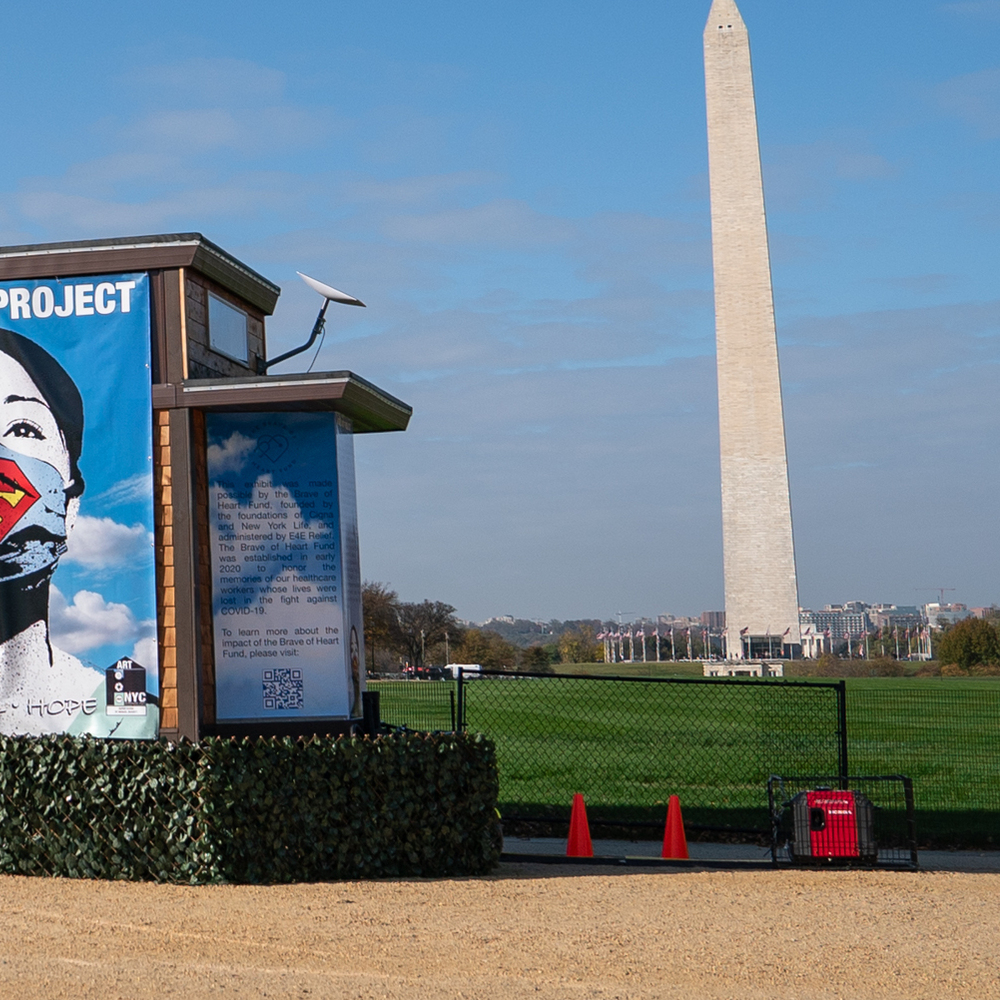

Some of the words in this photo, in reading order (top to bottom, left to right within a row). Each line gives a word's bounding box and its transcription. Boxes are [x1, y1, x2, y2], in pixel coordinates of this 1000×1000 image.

[218, 480, 235, 488] This
[244, 480, 273, 488] exhibit
[309, 479, 333, 487] made
[217, 490, 253, 500] possible
[258, 490, 269, 500] by
[275, 490, 289, 498] the
[294, 490, 318, 498] Brave
[217, 502, 241, 510] Heart
[248, 501, 273, 510] Fund,
[280, 501, 315, 509] founded
[323, 501, 333, 510] by
[218, 512, 231, 520] the
[238, 512, 288, 520] foundations
[294, 511, 303, 519] of
[309, 511, 334, 520] Cigna
[241, 522, 261, 530] New
[293, 521, 311, 530] Life,
[318, 521, 334, 529] and
[218, 533, 273, 541] administered
[275, 532, 286, 541] by
[289, 532, 306, 540] E4E
[309, 532, 334, 540] Relief.
[218, 544, 235, 552] The
[240, 543, 266, 551] Brave
[313, 542, 335, 550] Fund
[244, 553, 293, 562] established
[300, 553, 308, 561] in
[315, 553, 335, 562] early
[219, 565, 241, 573] 2020
[282, 564, 306, 572] honor
[322, 563, 336, 571] the
[220, 575, 262, 583] memories
[293, 574, 336, 582] healthcare
[220, 586, 254, 594] workers
[260, 585, 287, 593] whose
[220, 597, 237, 605] lost
[280, 595, 299, 605] fight
[307, 595, 337, 605] against
[220, 607, 267, 615] COVID-19.
[221, 629, 232, 637] To
[238, 628, 260, 636] learn
[294, 627, 319, 635] about
[222, 639, 251, 648] impact
[264, 638, 278, 646] the
[280, 638, 304, 646] Brave
[306, 637, 315, 645] of
[316, 637, 339, 645] Heart
[222, 649, 247, 658] Fund,
[249, 649, 278, 659] please
[279, 648, 299, 656] visit:
[116, 660, 133, 670] ART
[124, 692, 146, 702] NYC
[26, 697, 97, 716] HOPE
